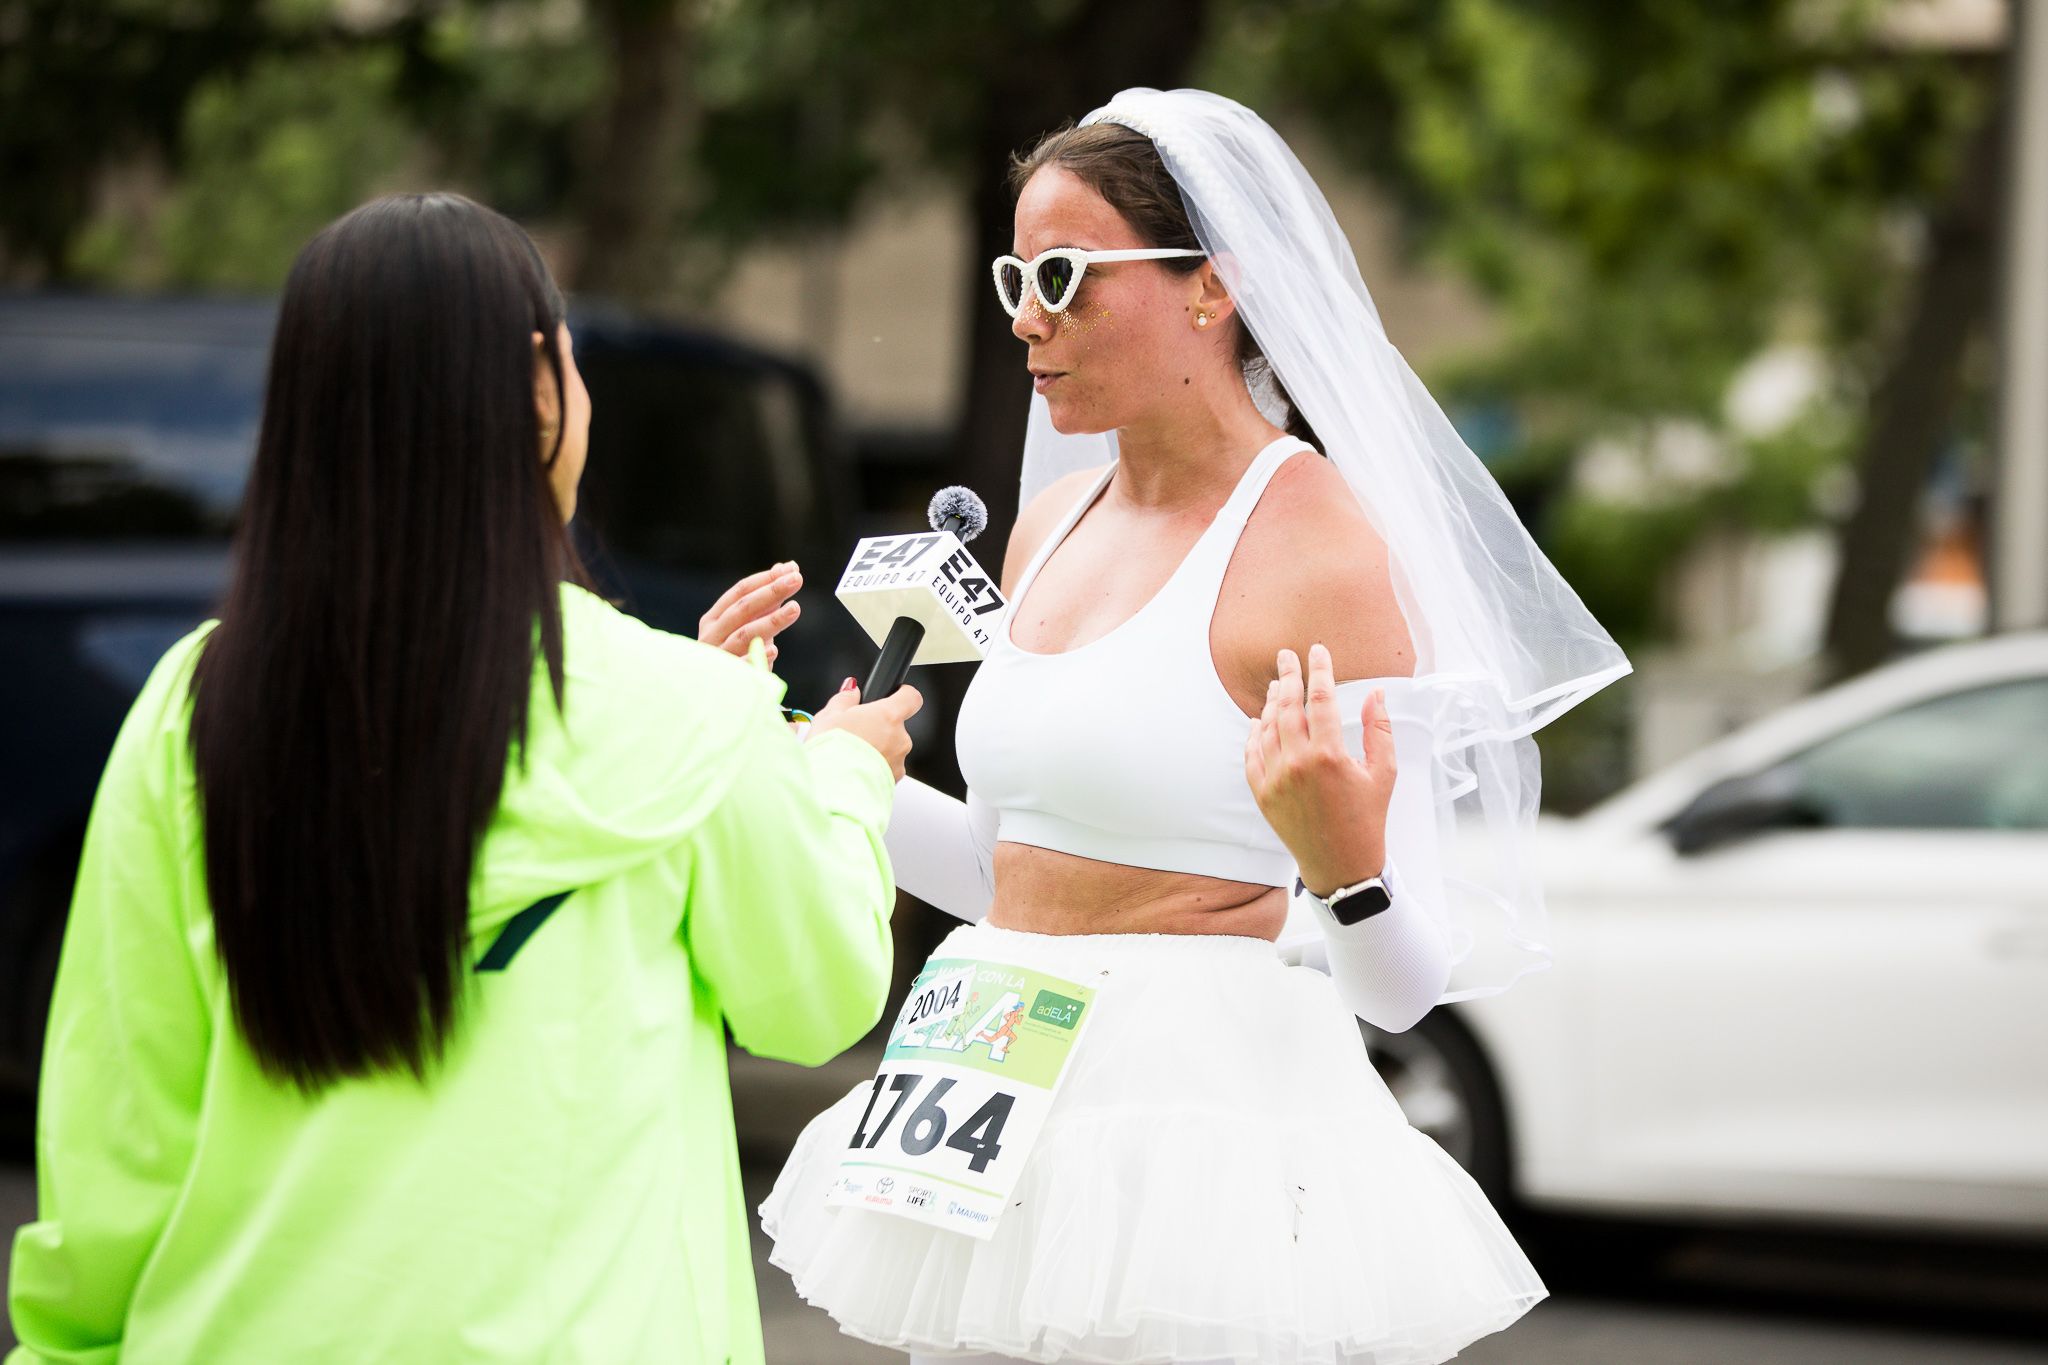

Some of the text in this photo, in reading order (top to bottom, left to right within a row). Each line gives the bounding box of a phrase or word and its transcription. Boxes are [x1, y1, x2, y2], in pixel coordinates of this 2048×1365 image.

[851, 535, 942, 571] E47
[844, 570, 926, 587] EQUIPO 47
[939, 547, 1004, 616] E47
[931, 576, 989, 645] EQUIPO 47
[977, 970, 1004, 986] CON
[908, 980, 962, 1025] 2004
[848, 1073, 1016, 1173] 1764
[906, 1195, 926, 1207] LIFE
[908, 1185, 932, 1198] SPORT
[956, 1207, 989, 1223] MADRID
